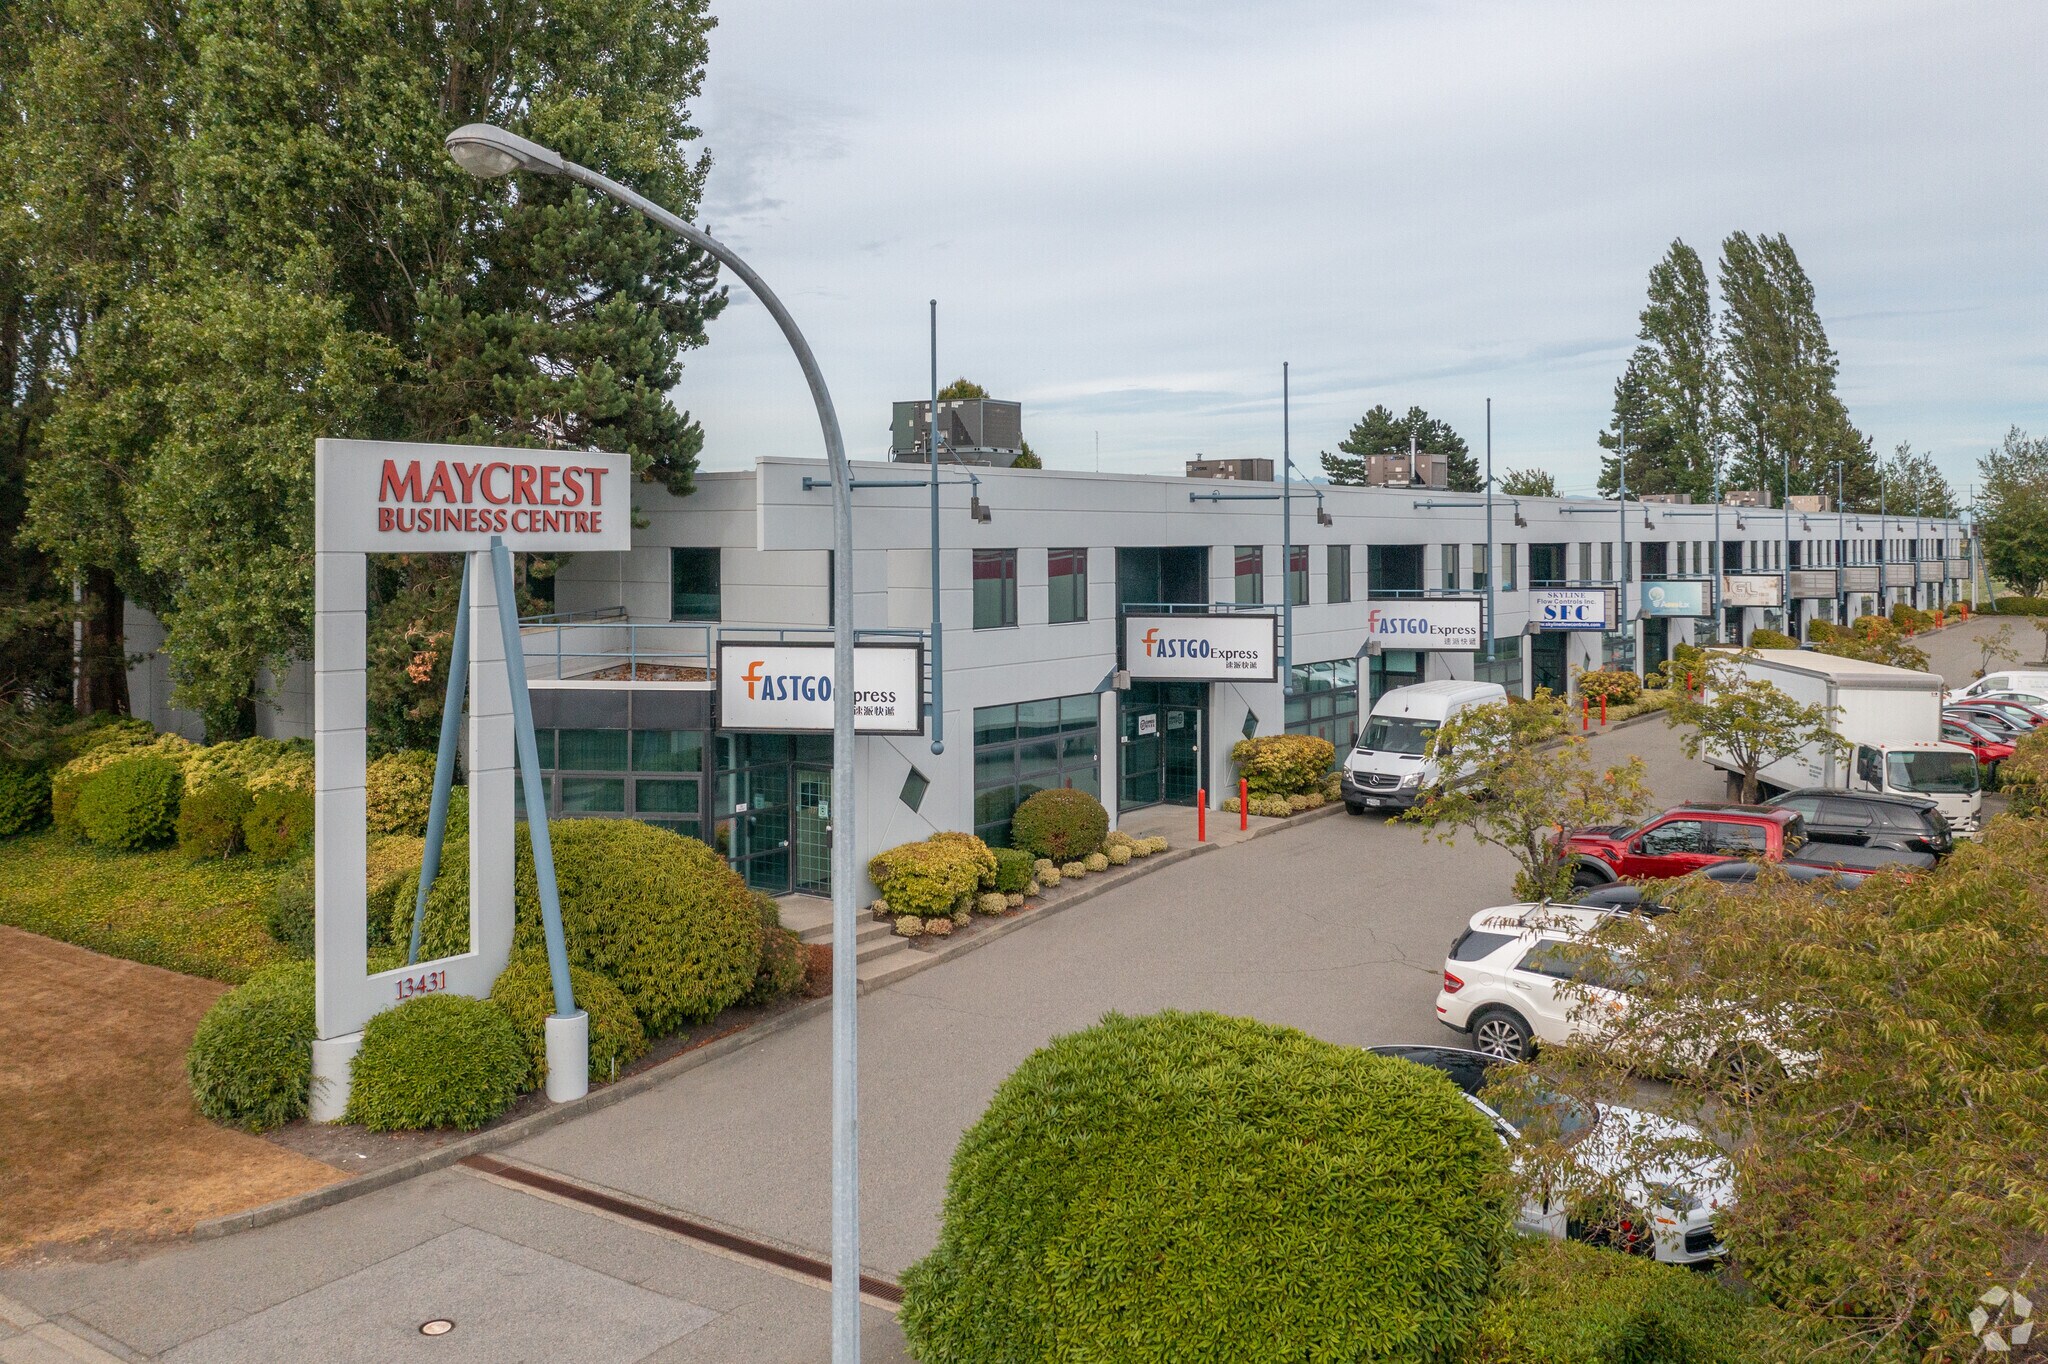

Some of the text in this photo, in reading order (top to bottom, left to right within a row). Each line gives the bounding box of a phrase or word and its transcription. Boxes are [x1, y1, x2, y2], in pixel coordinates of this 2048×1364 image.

[378, 459, 609, 507] MAYCREST
[378, 507, 602, 533] BUSINESS CENTRE
[1543, 605, 1590, 620] SFC
[1430, 625, 1477, 636] Express
[1210, 648, 1258, 661] Express
[833, 688, 897, 705] press
[395, 970, 446, 1000] 13431
